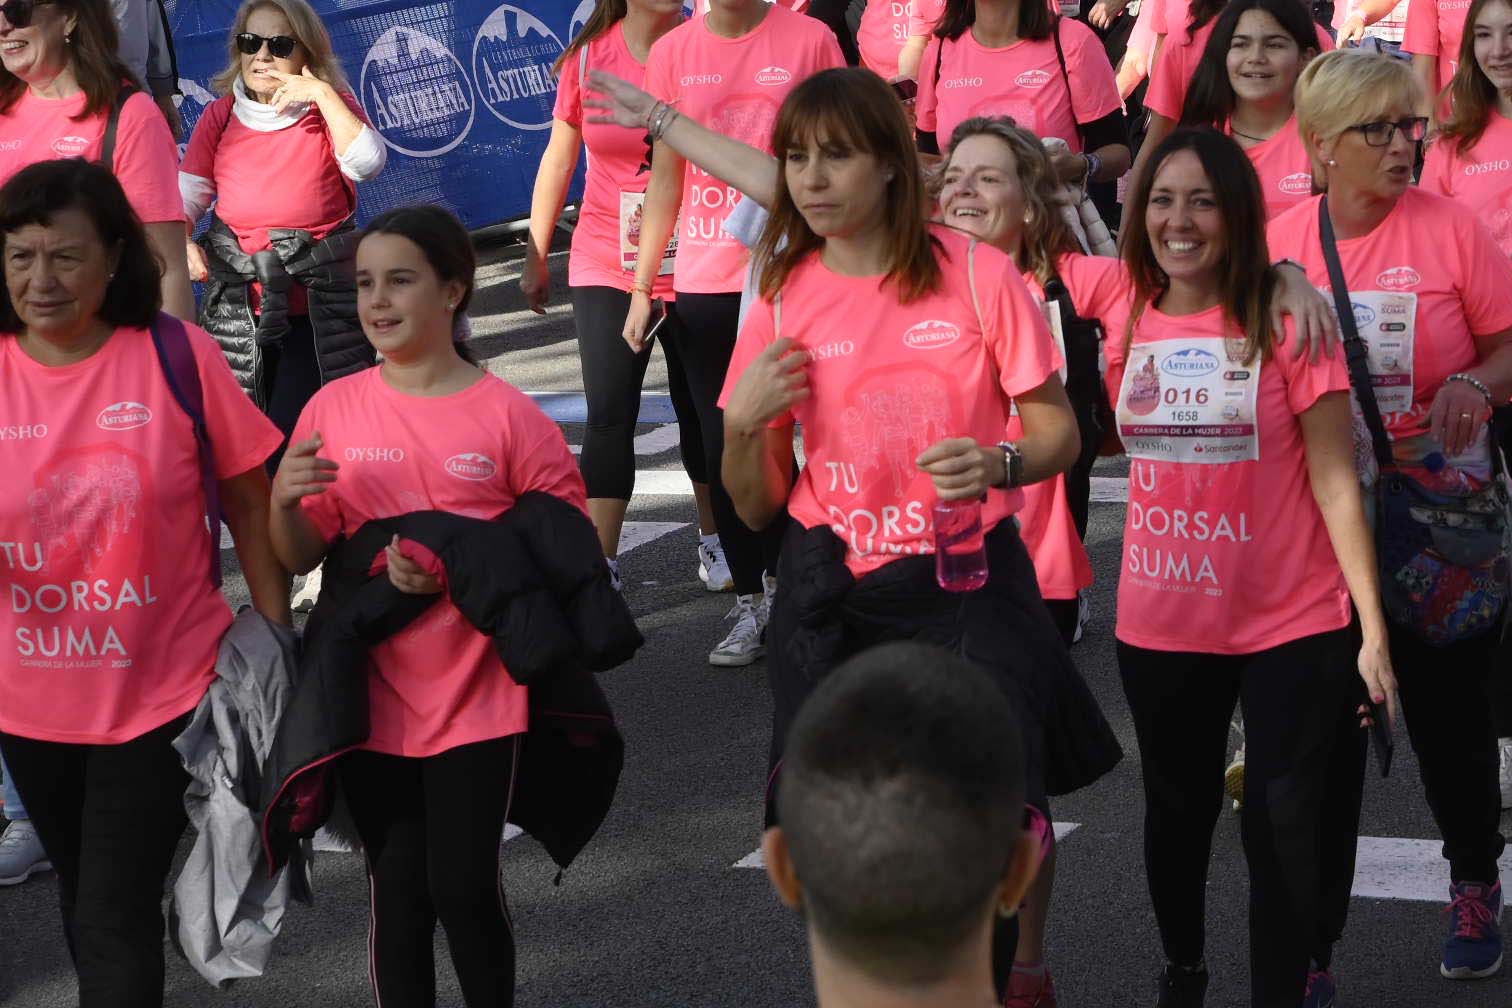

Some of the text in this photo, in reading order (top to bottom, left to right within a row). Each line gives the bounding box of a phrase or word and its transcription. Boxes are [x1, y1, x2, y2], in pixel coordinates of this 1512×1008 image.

[372, 79, 471, 131] ASTURIANA
[1464, 160, 1511, 178] OYSHO
[1166, 359, 1215, 372] ASTURIANA
[1163, 387, 1209, 405] 016
[1171, 410, 1199, 422] 1658
[1133, 427, 1168, 435] CARRERA
[1169, 427, 1181, 435] DE
[1182, 427, 1193, 435] LA
[1195, 427, 1222, 435] MUJER
[344, 447, 404, 462] OYSHO
[1204, 442, 1248, 454] Santander
[825, 461, 859, 494] TU
[1132, 502, 1253, 542] DORSAL
[1, 542, 44, 572] TU
[1128, 543, 1219, 584] SUMA
[10, 575, 158, 614] DORSAL
[15, 624, 127, 657] SUMA
